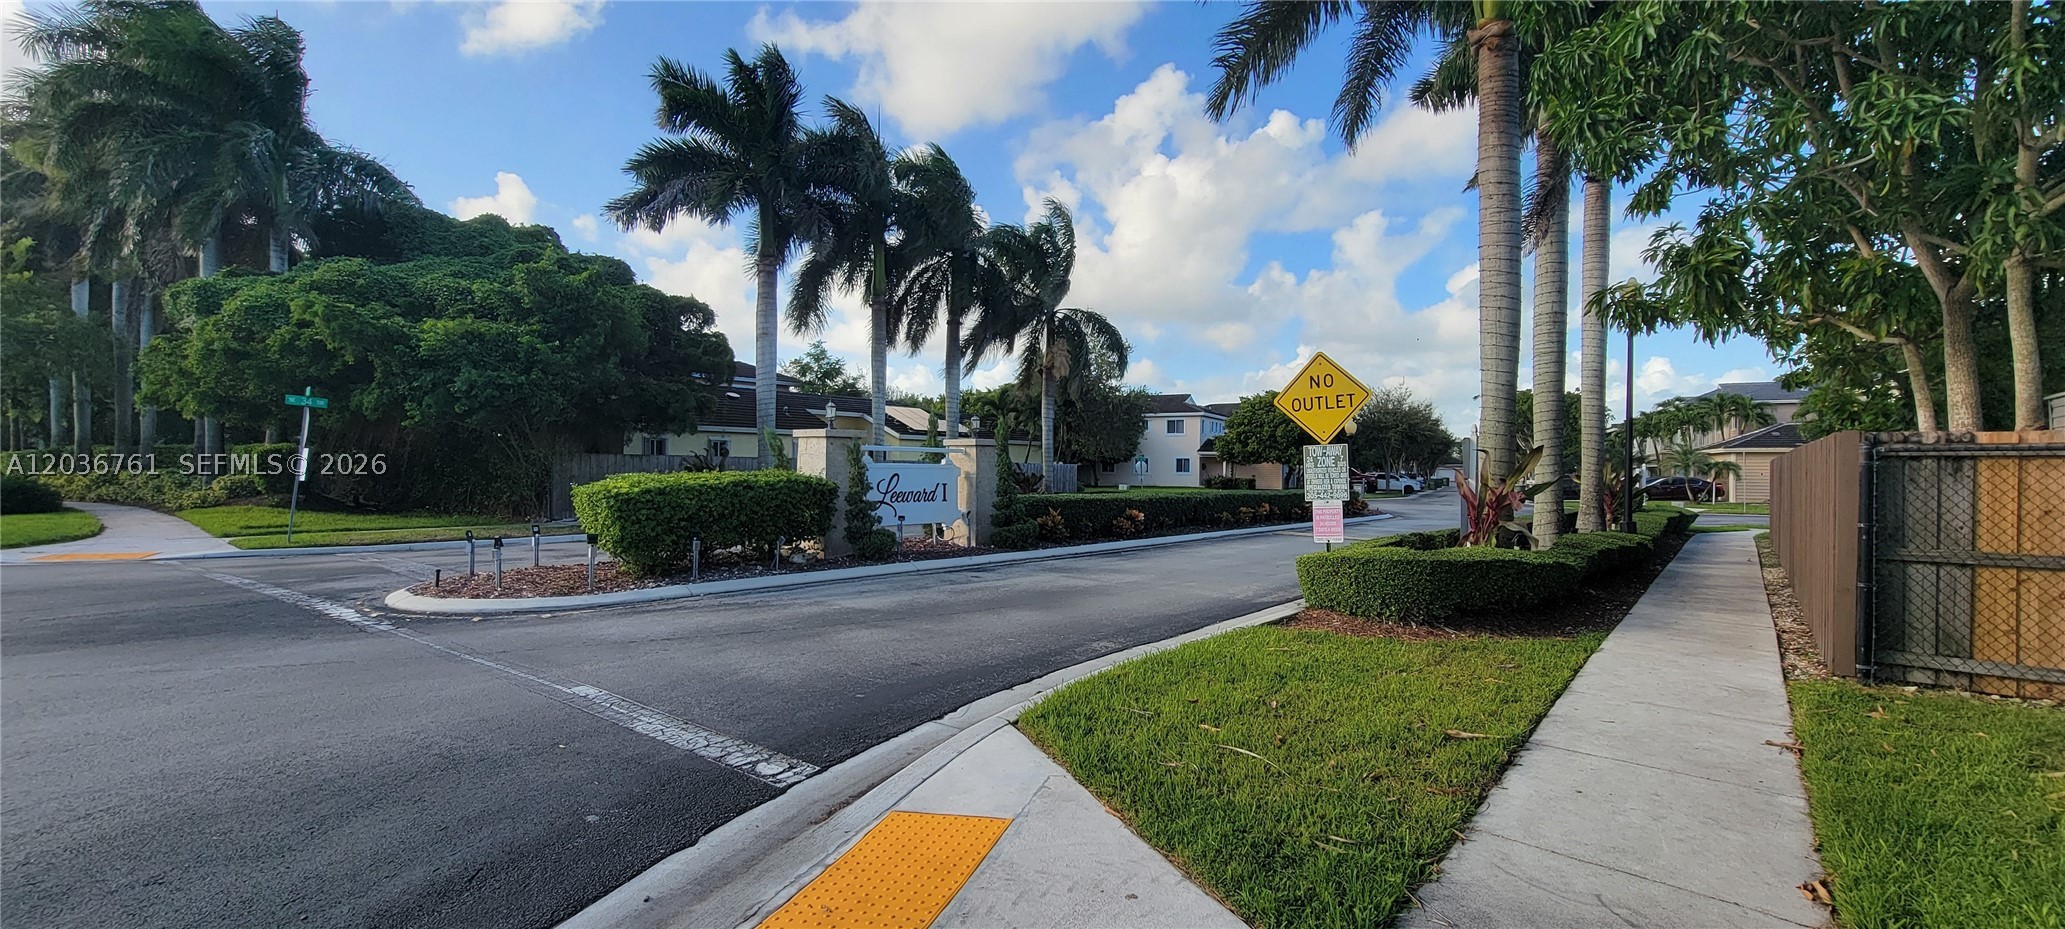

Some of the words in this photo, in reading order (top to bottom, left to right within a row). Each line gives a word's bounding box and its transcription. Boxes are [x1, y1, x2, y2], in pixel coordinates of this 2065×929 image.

[1309, 373, 1334, 389] NO
[301, 397, 312, 406] 34
[1291, 393, 1355, 412] OUTLET
[1309, 445, 1343, 457] TOW-AWAY
[1317, 456, 1336, 468] ZONE
[870, 472, 940, 518] Leeward
[941, 482, 948, 502] I
